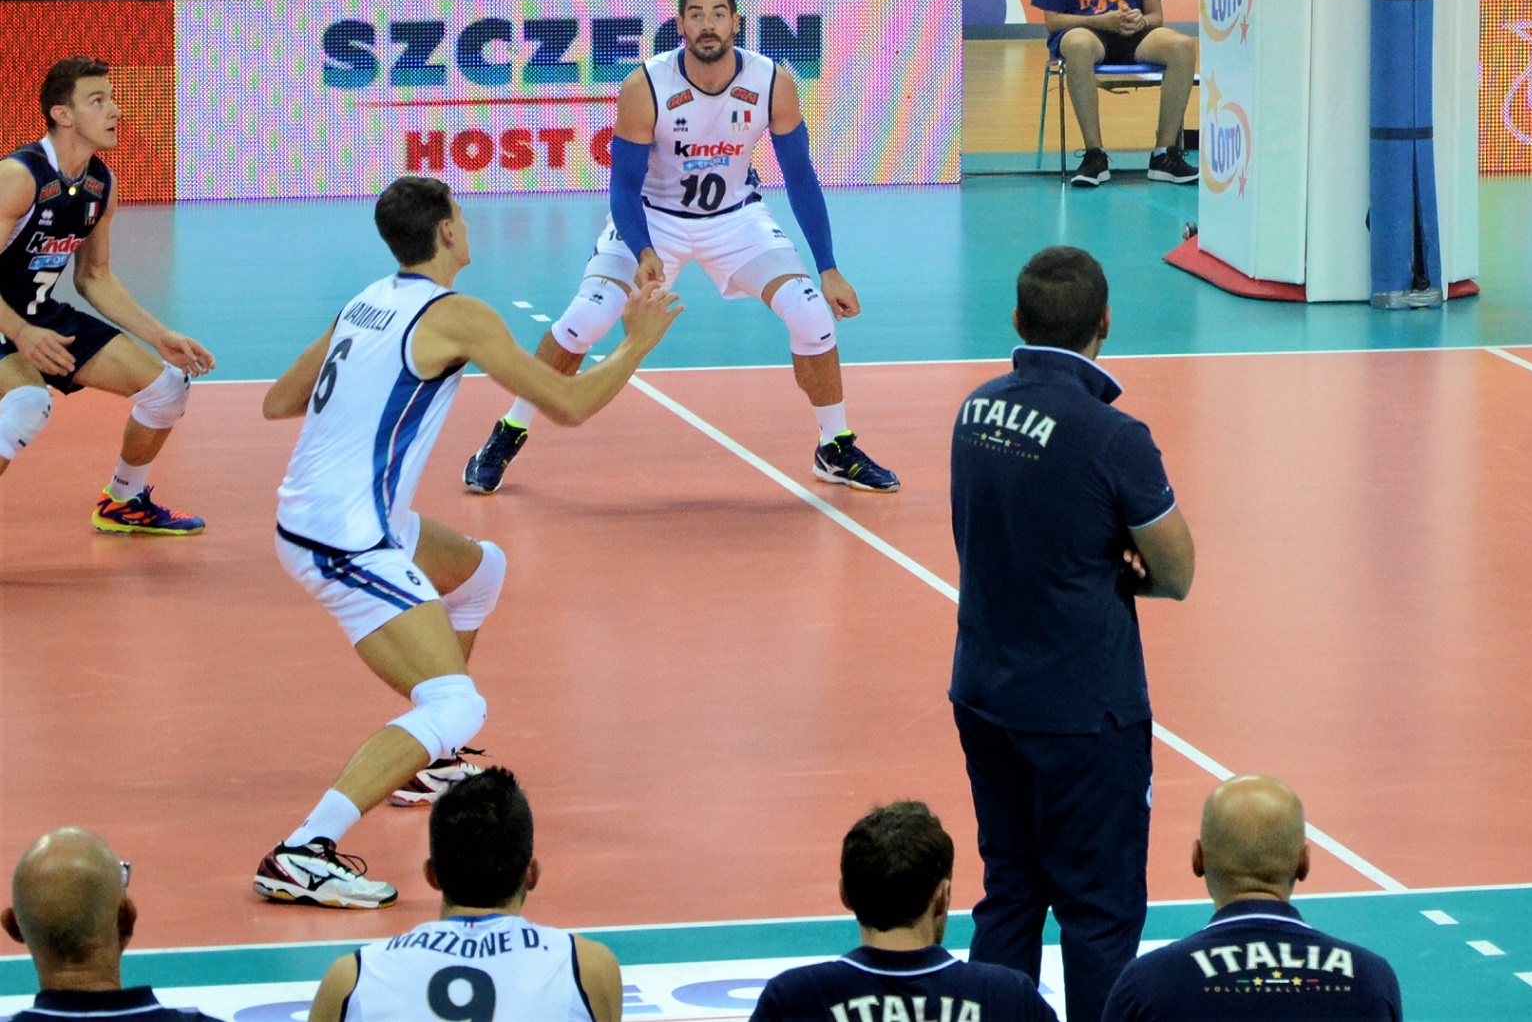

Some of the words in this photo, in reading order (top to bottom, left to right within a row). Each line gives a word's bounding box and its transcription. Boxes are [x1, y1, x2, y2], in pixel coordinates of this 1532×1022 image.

[406, 128, 575, 172] HOST
[674, 141, 744, 157] kinder
[699, 156, 729, 169] SPORT
[1210, 123, 1242, 175] LOTTO
[680, 173, 726, 211] 10
[26, 272, 60, 315] 7
[313, 338, 353, 414] 6
[962, 397, 1057, 448] ITALIA
[385, 931, 513, 959] MAZZONE
[521, 928, 549, 951] D.
[1190, 941, 1354, 978] ITALIA
[427, 965, 496, 1022] 9
[829, 995, 981, 1022] ITALIA
